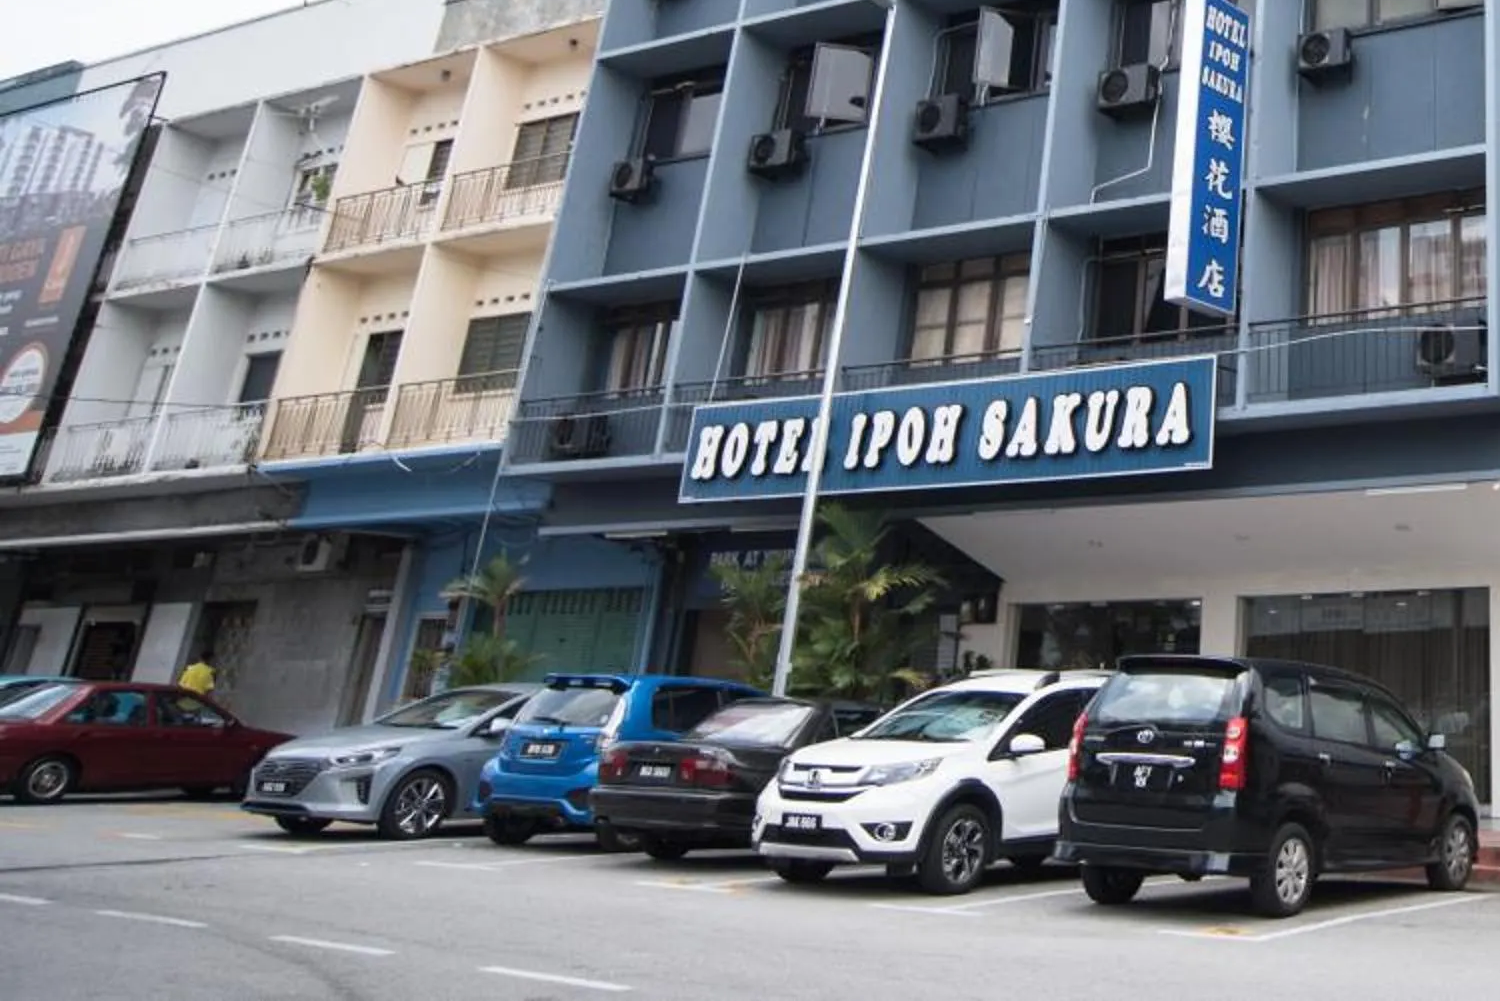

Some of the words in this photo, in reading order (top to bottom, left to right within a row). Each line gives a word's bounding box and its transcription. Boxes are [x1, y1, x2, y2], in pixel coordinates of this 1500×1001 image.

[1206, 5, 1246, 49] HOTEL
[1208, 40, 1241, 73] IPOH
[842, 404, 963, 471] IPOH
[977, 381, 1191, 461] SAKURA
